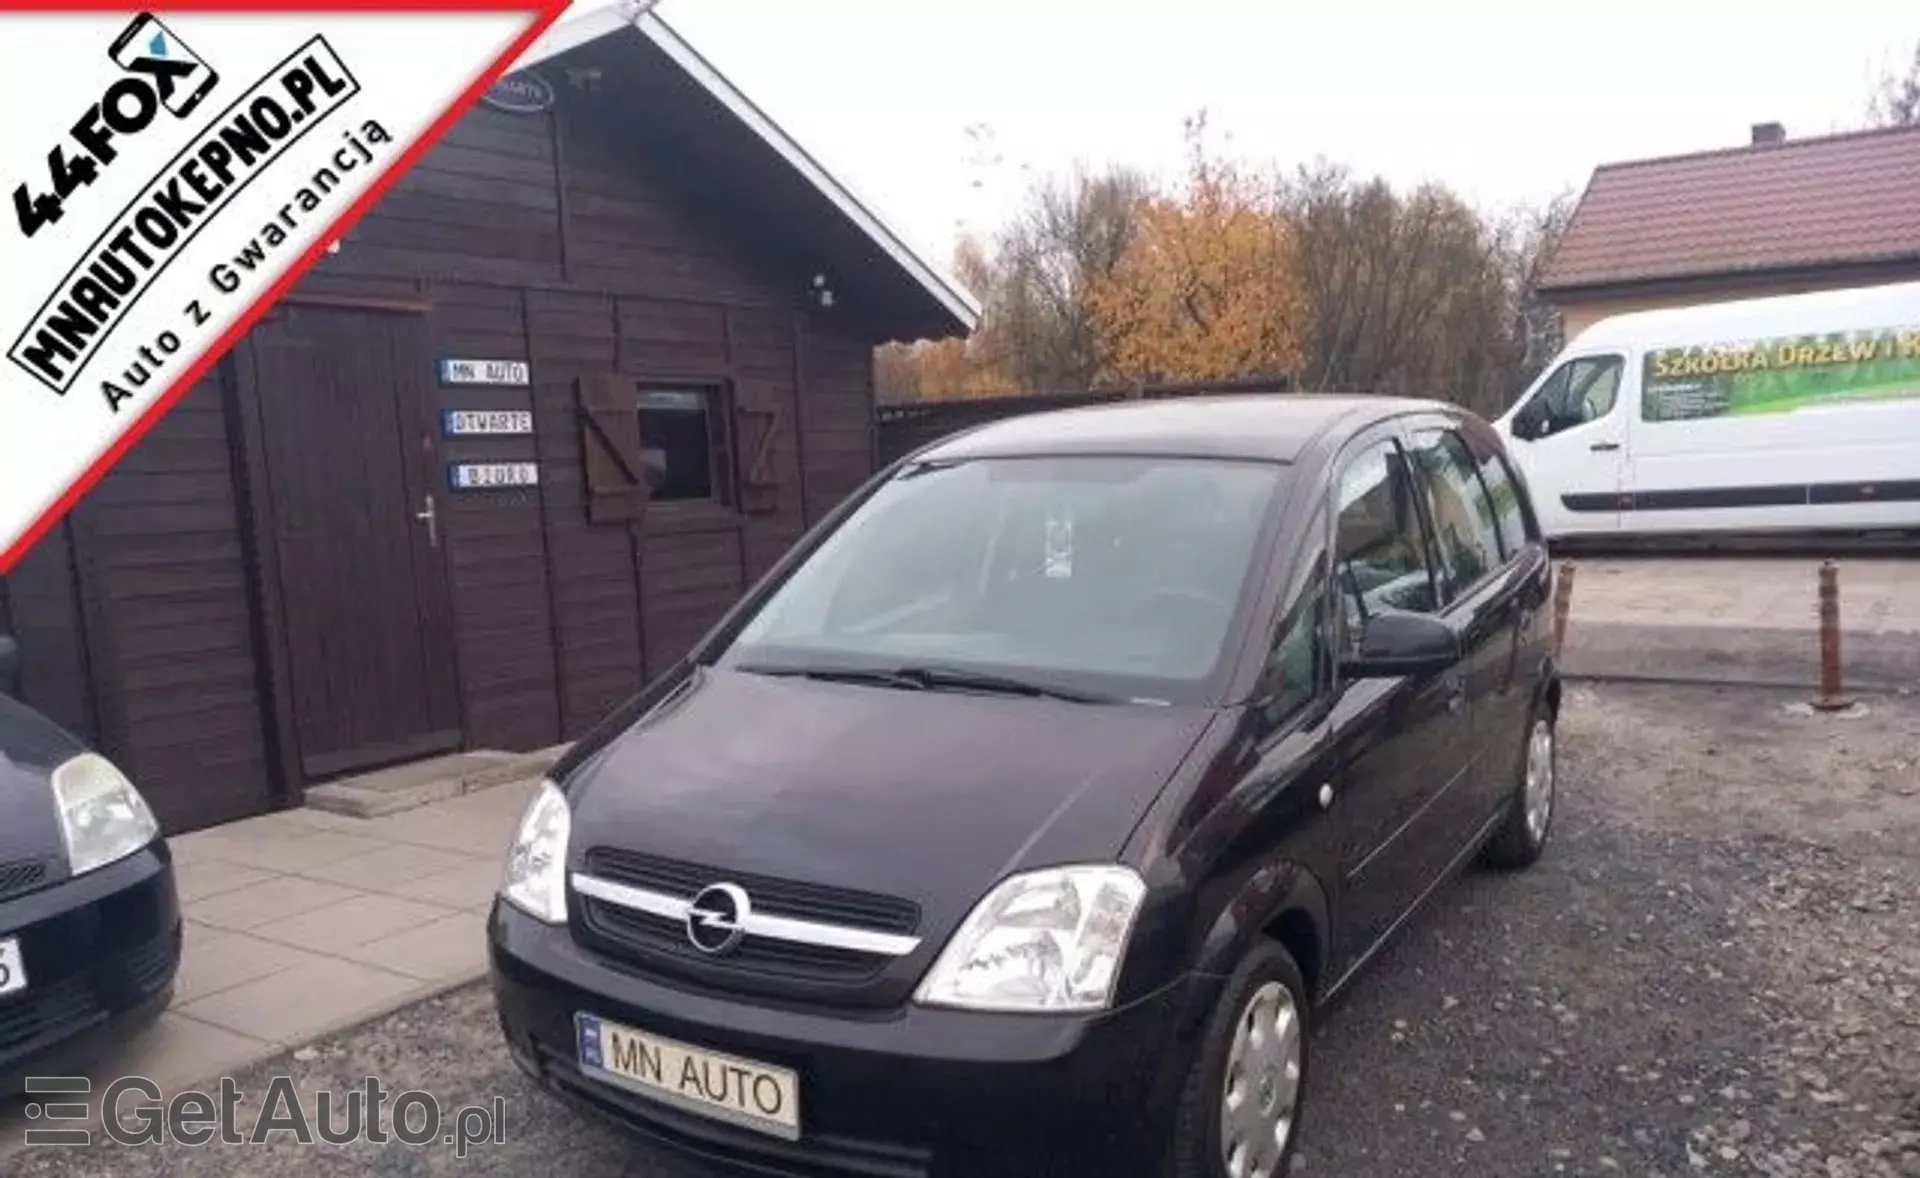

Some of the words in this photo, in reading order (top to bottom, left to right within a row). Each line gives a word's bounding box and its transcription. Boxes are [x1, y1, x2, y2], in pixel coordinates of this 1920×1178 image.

[1778, 338, 1876, 367] DRZEW
[456, 413, 530, 430] OTWARTE
[611, 1031, 662, 1082] MN
[679, 1056, 782, 1115] AUTO
